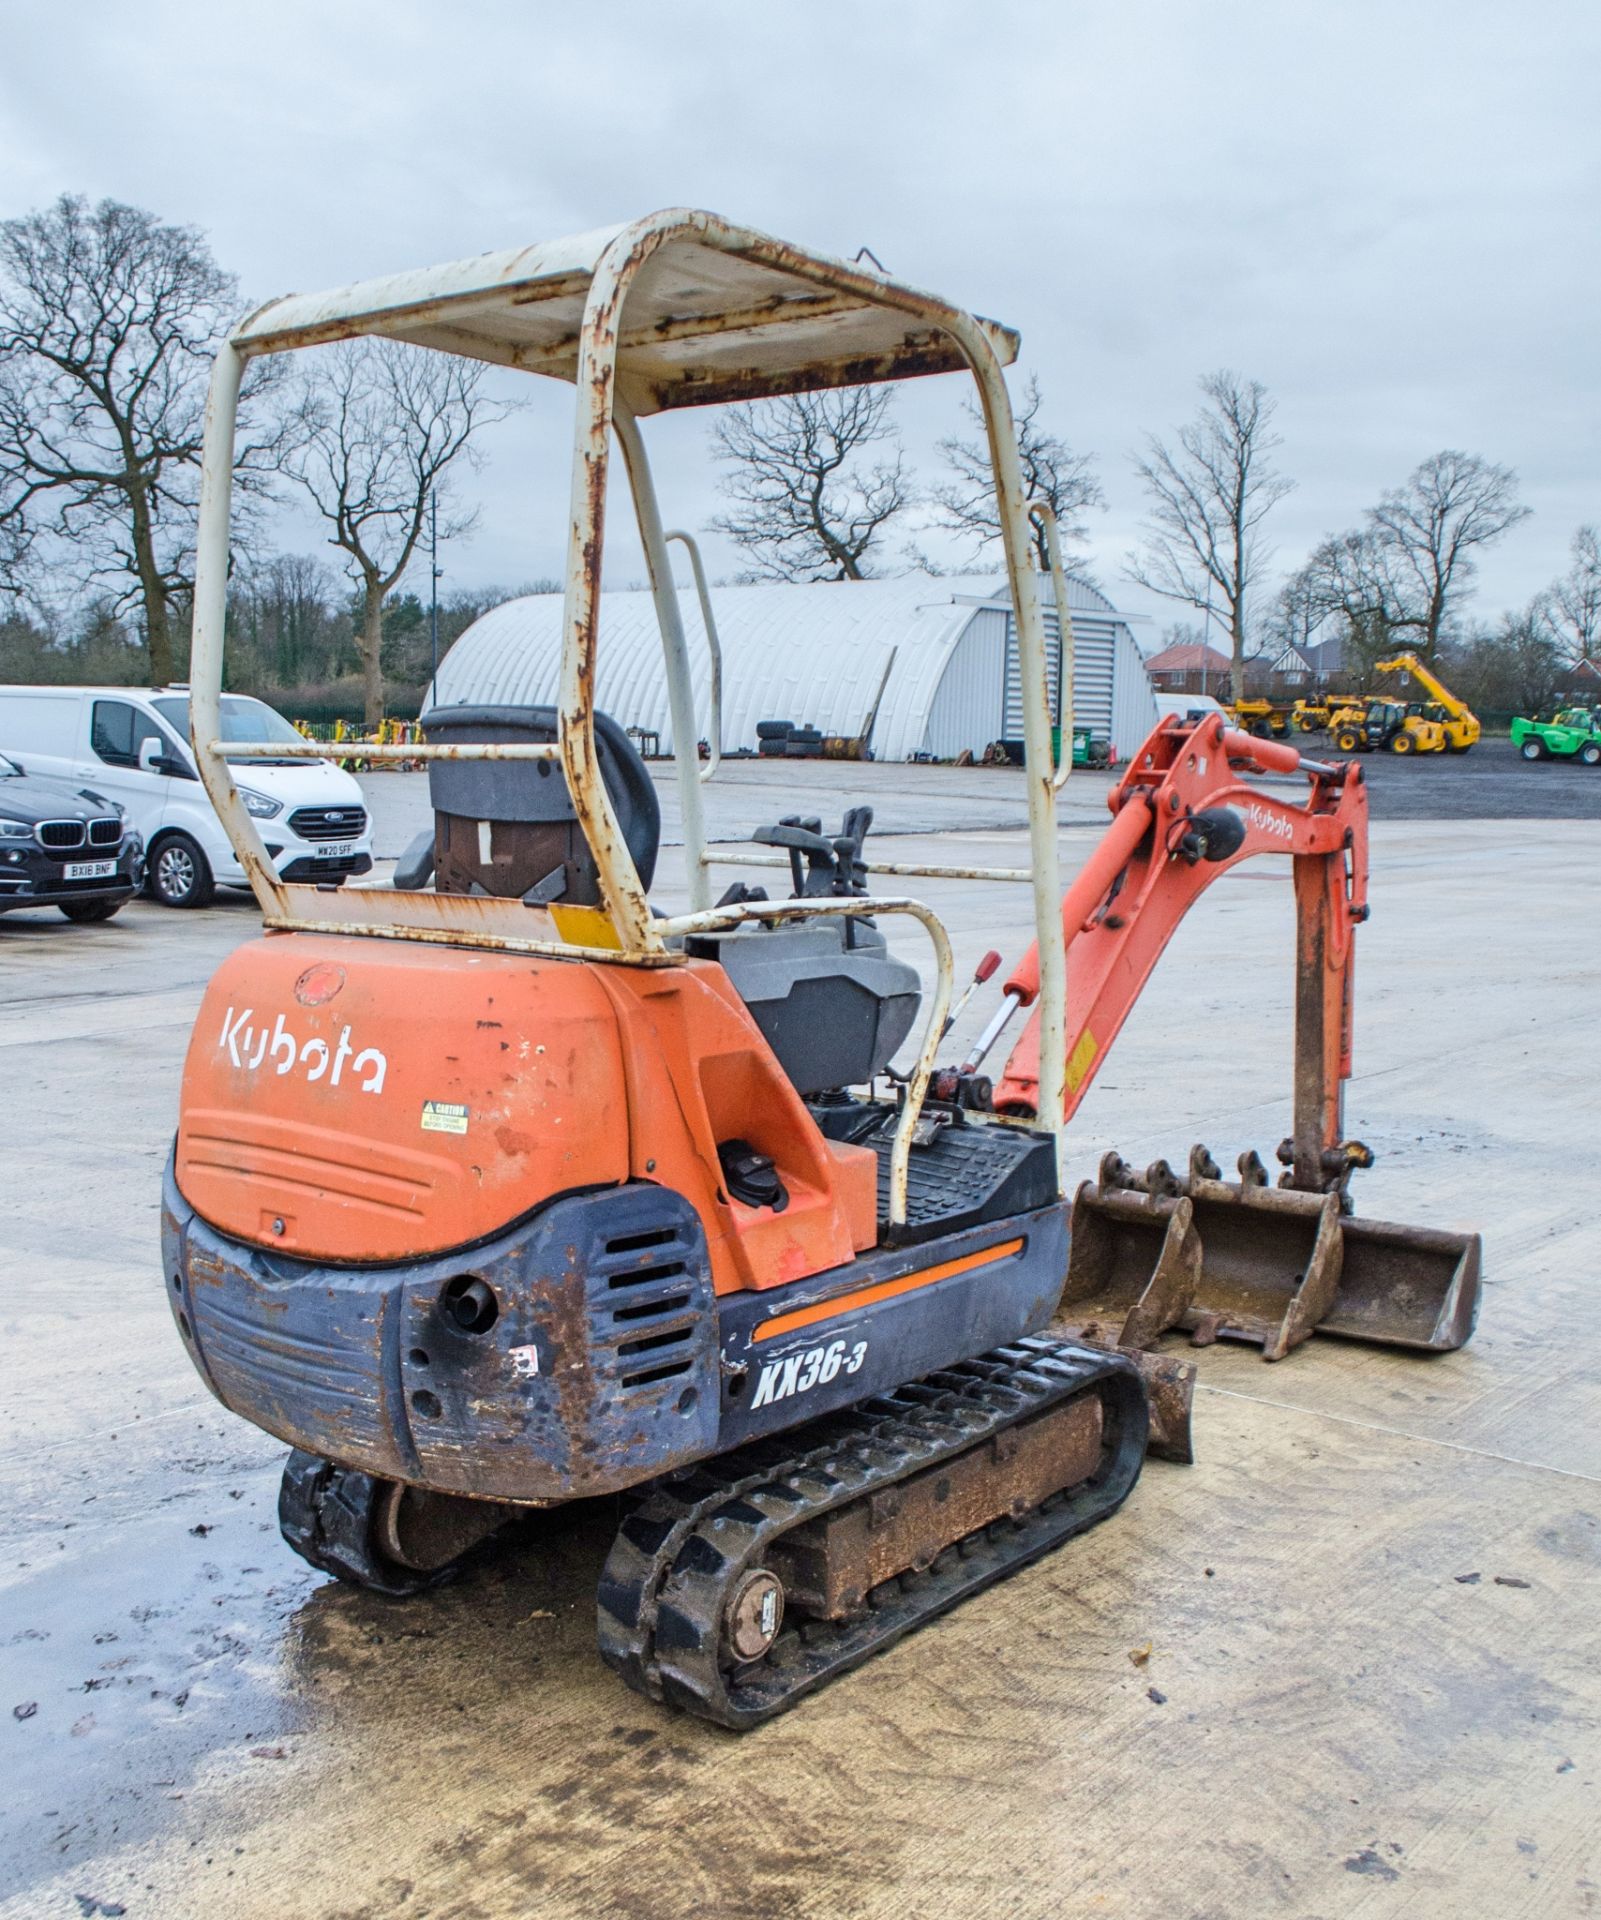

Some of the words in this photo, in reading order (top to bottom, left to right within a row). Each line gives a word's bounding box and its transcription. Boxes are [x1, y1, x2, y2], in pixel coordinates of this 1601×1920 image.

[1250, 803, 1293, 839] Kubota
[71, 865, 93, 876] BX18
[95, 863, 112, 875] BNF
[219, 1006, 387, 1094] Kubota
[435, 1103, 465, 1116] CAUTION
[750, 1340, 868, 1410] KX36-3
